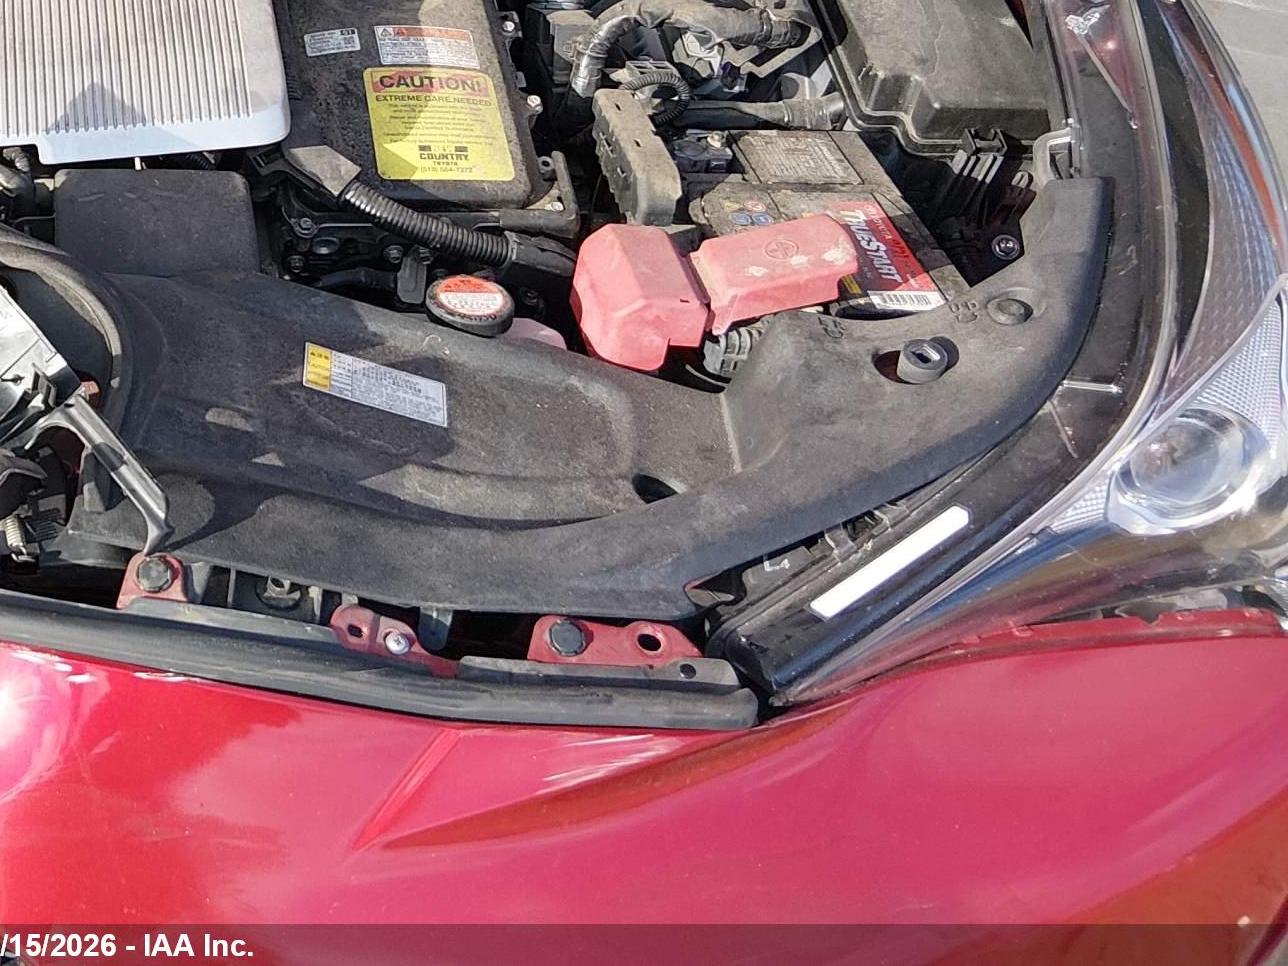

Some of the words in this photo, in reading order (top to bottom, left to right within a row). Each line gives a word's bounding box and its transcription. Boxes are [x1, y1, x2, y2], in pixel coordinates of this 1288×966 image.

[378, 74, 482, 92] CAUTION!
[375, 94, 423, 102] EXTREME
[424, 95, 453, 103] CARE
[453, 97, 492, 107] NEEDED
[419, 152, 470, 162] COUNTRY
